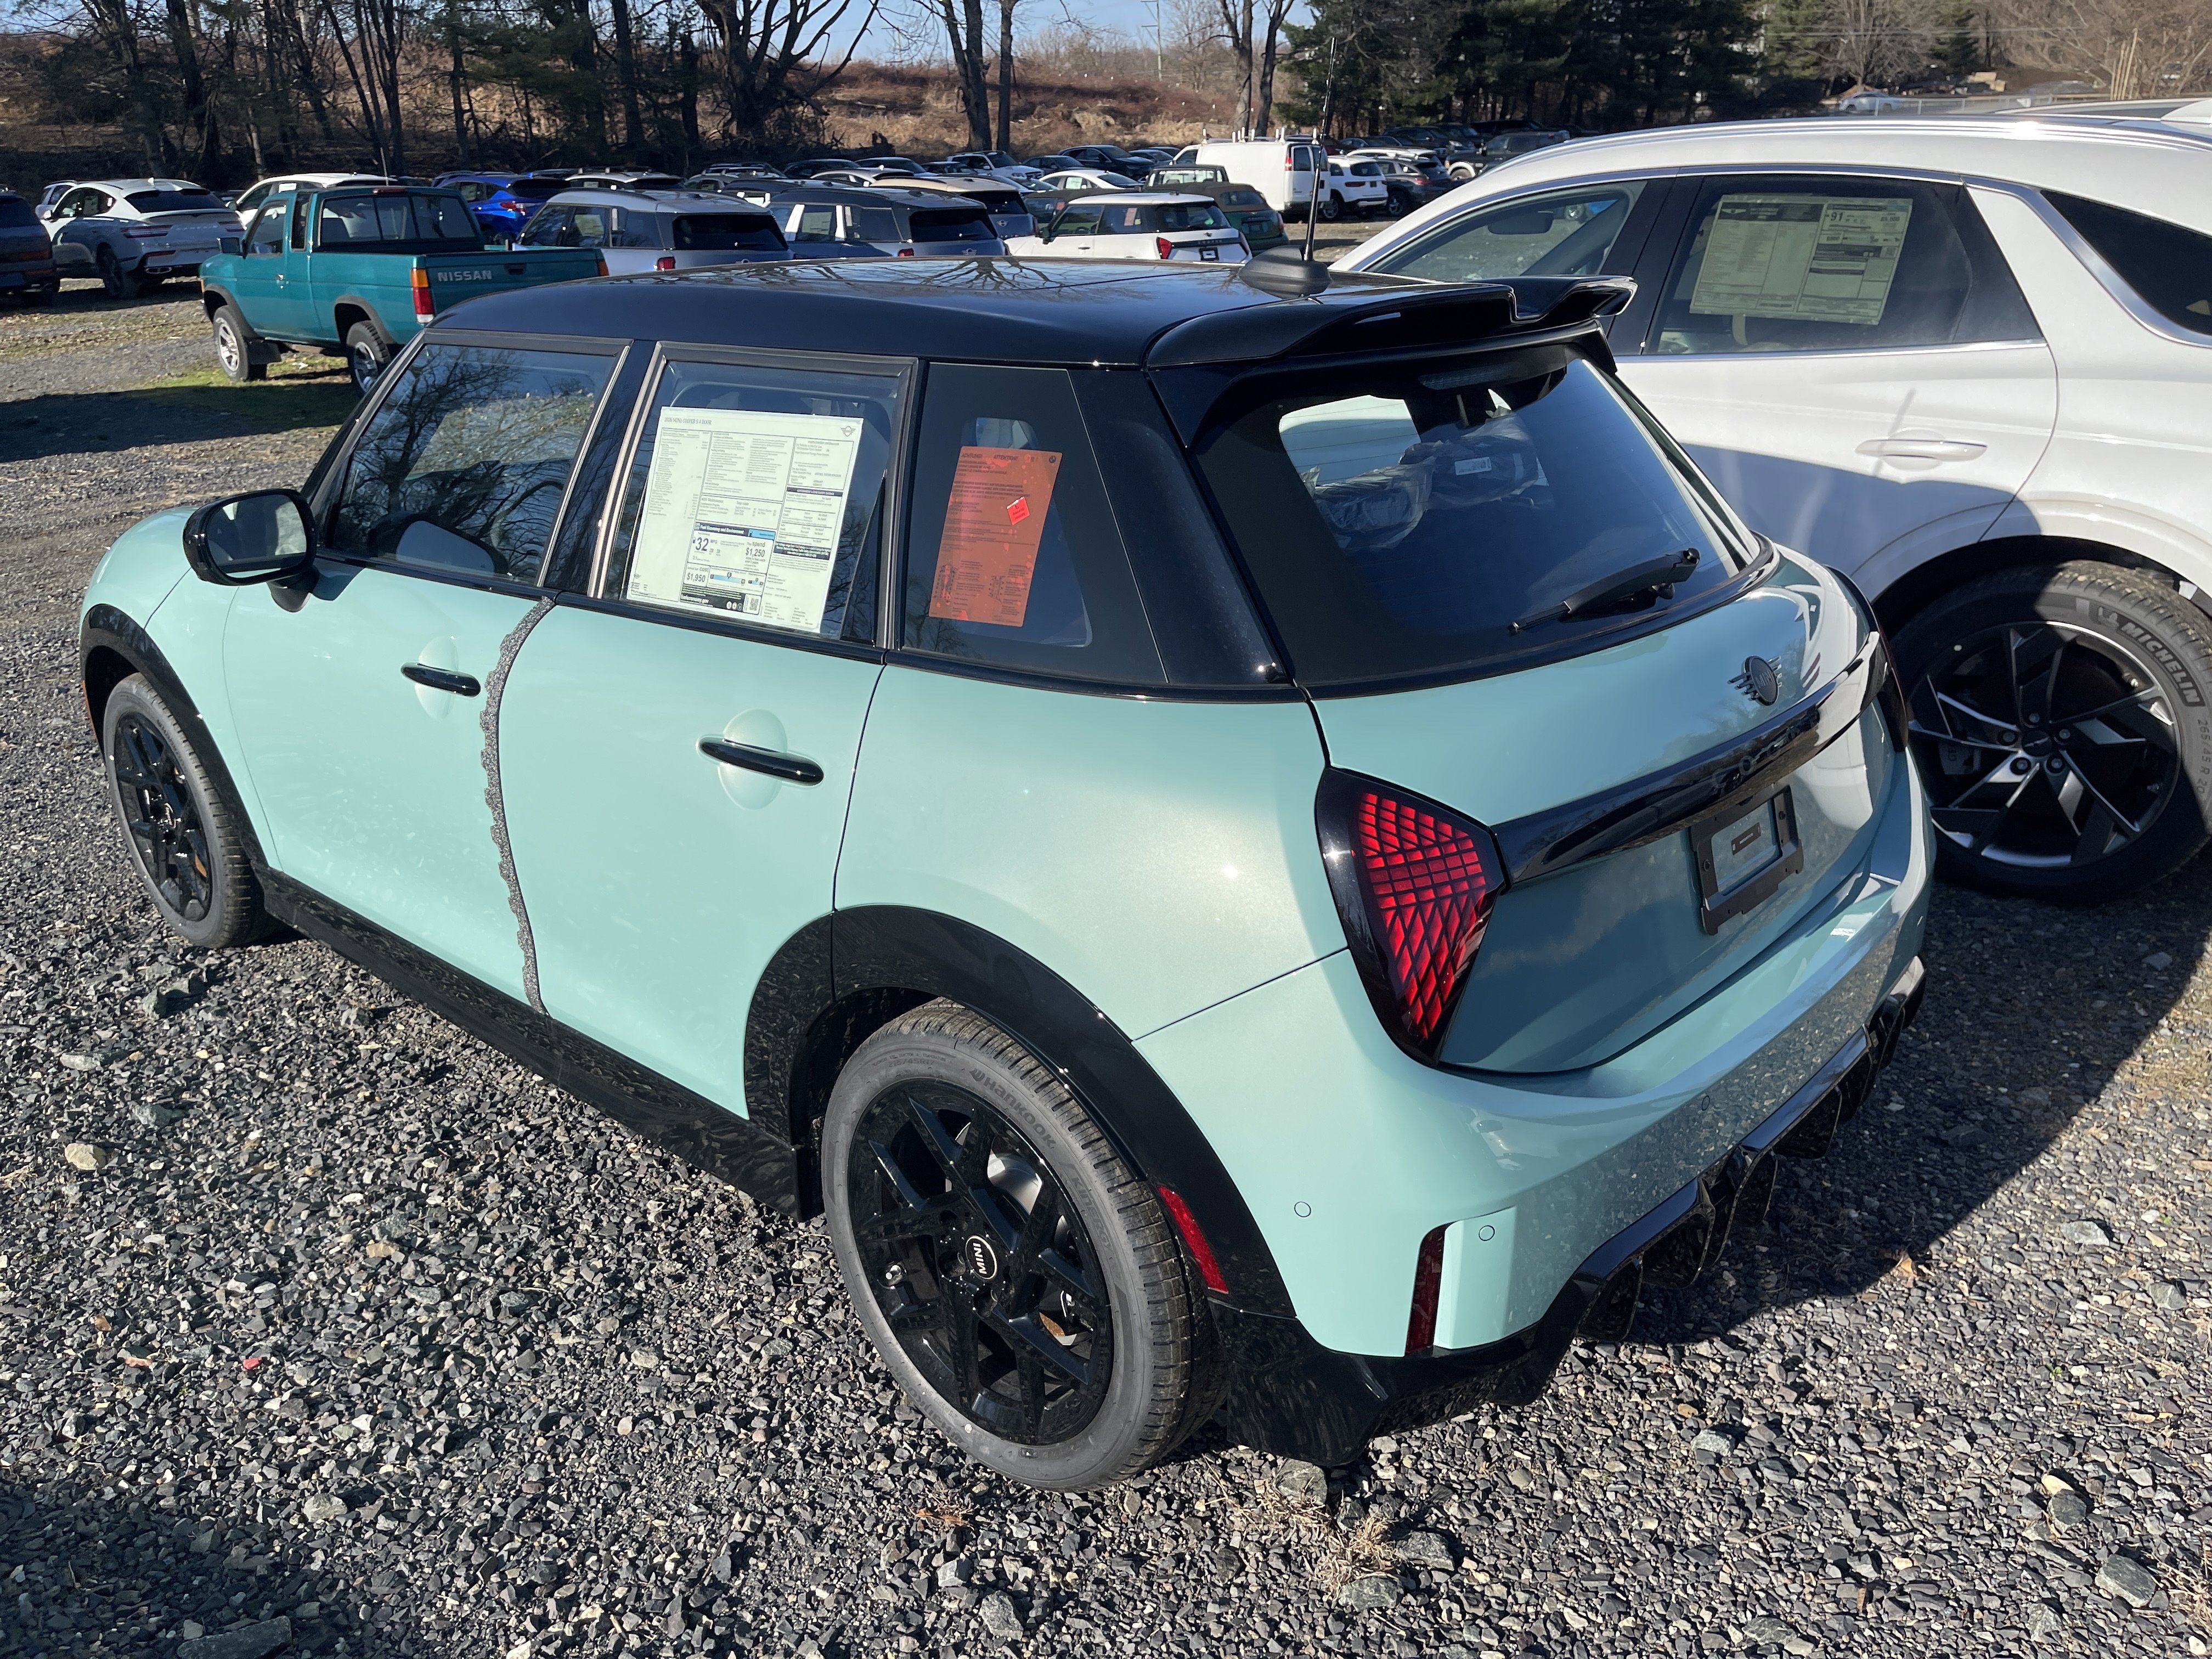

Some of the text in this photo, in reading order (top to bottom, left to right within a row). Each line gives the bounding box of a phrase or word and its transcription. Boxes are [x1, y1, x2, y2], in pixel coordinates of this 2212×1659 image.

[438, 270, 492, 282] NISSAN
[695, 537, 709, 551] 32
[746, 548, 765, 557] $1,250
[687, 573, 706, 582] $1,950
[2121, 622, 2200, 702] MICHELIN
[2196, 777, 2208, 795] 20
[973, 1243, 987, 1274] MINI
